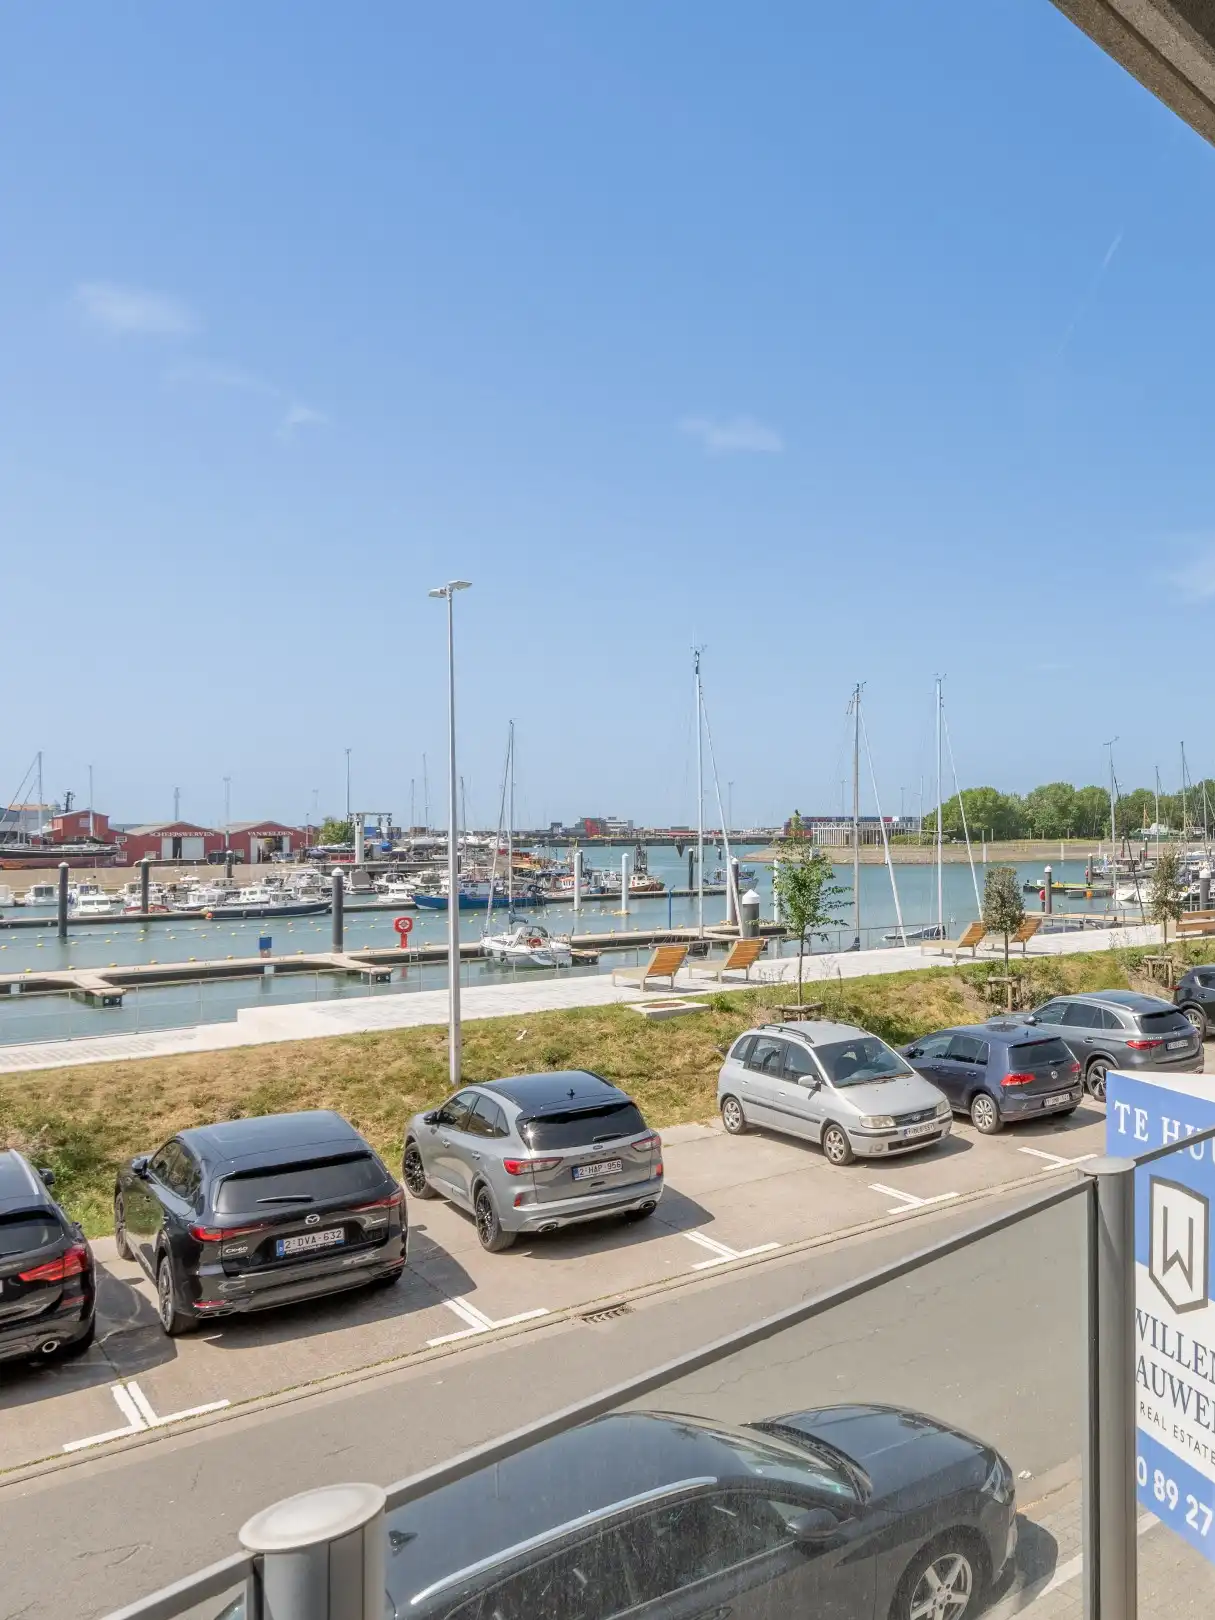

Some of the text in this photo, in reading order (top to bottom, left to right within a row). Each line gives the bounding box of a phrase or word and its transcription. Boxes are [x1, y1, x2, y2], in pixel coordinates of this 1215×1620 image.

[1114, 1100, 1149, 1142] TE
[285, 1230, 342, 1249] 2-DVA-632
[1139, 1401, 1167, 1432] REAL
[1154, 1469, 1179, 1511] 89
[1186, 1494, 1214, 1537] 27
